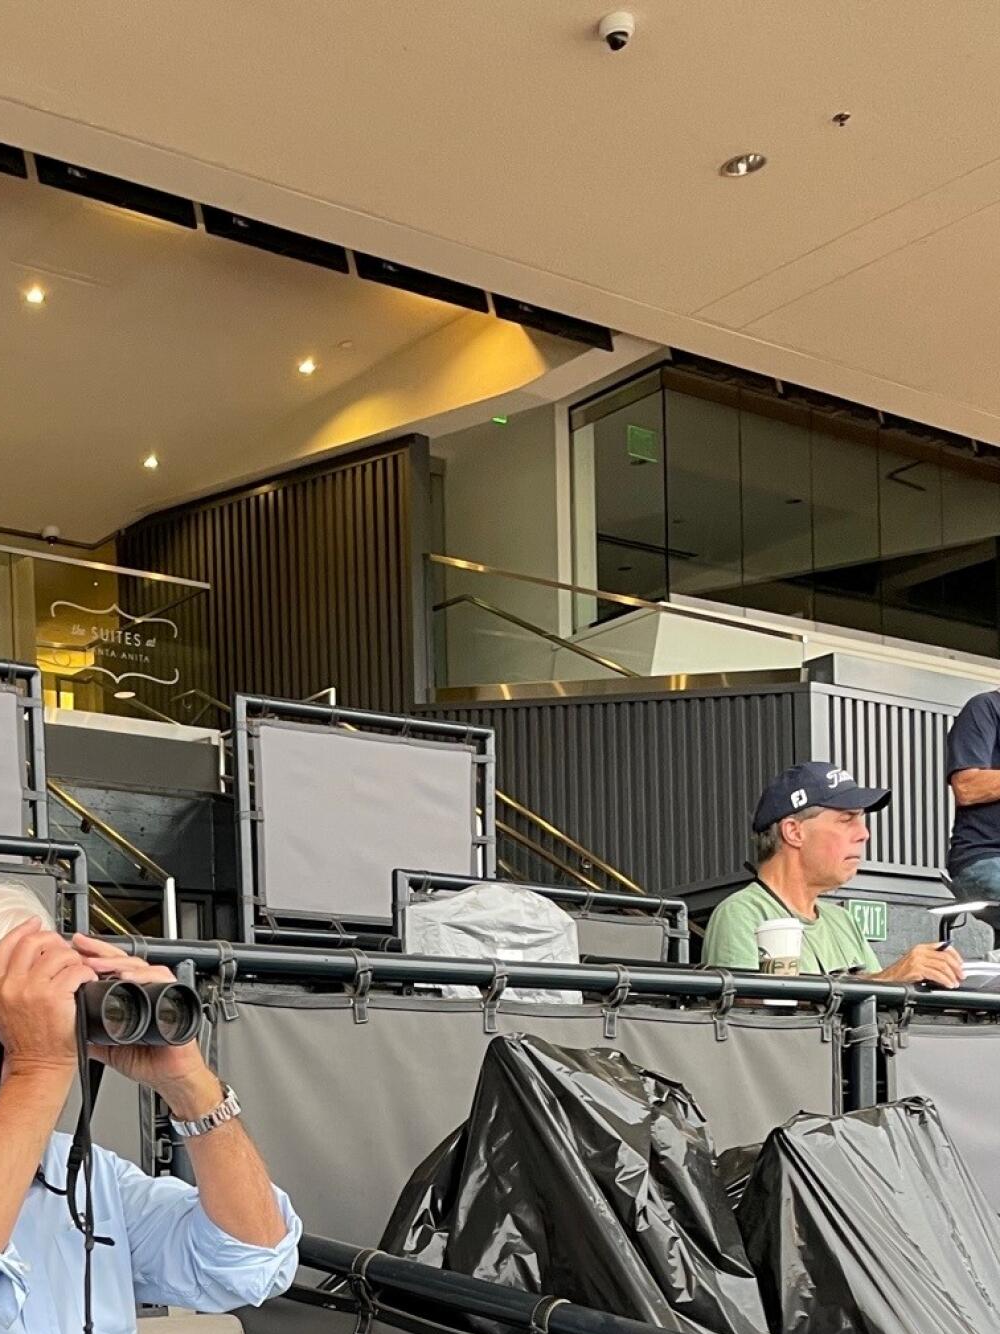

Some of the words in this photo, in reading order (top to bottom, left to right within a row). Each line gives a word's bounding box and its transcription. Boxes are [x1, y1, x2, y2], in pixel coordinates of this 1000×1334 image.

[91, 626, 141, 648] SUITES
[120, 652, 150, 664] ANITA
[790, 788, 808, 809] FJ
[854, 904, 882, 936] EXIT
